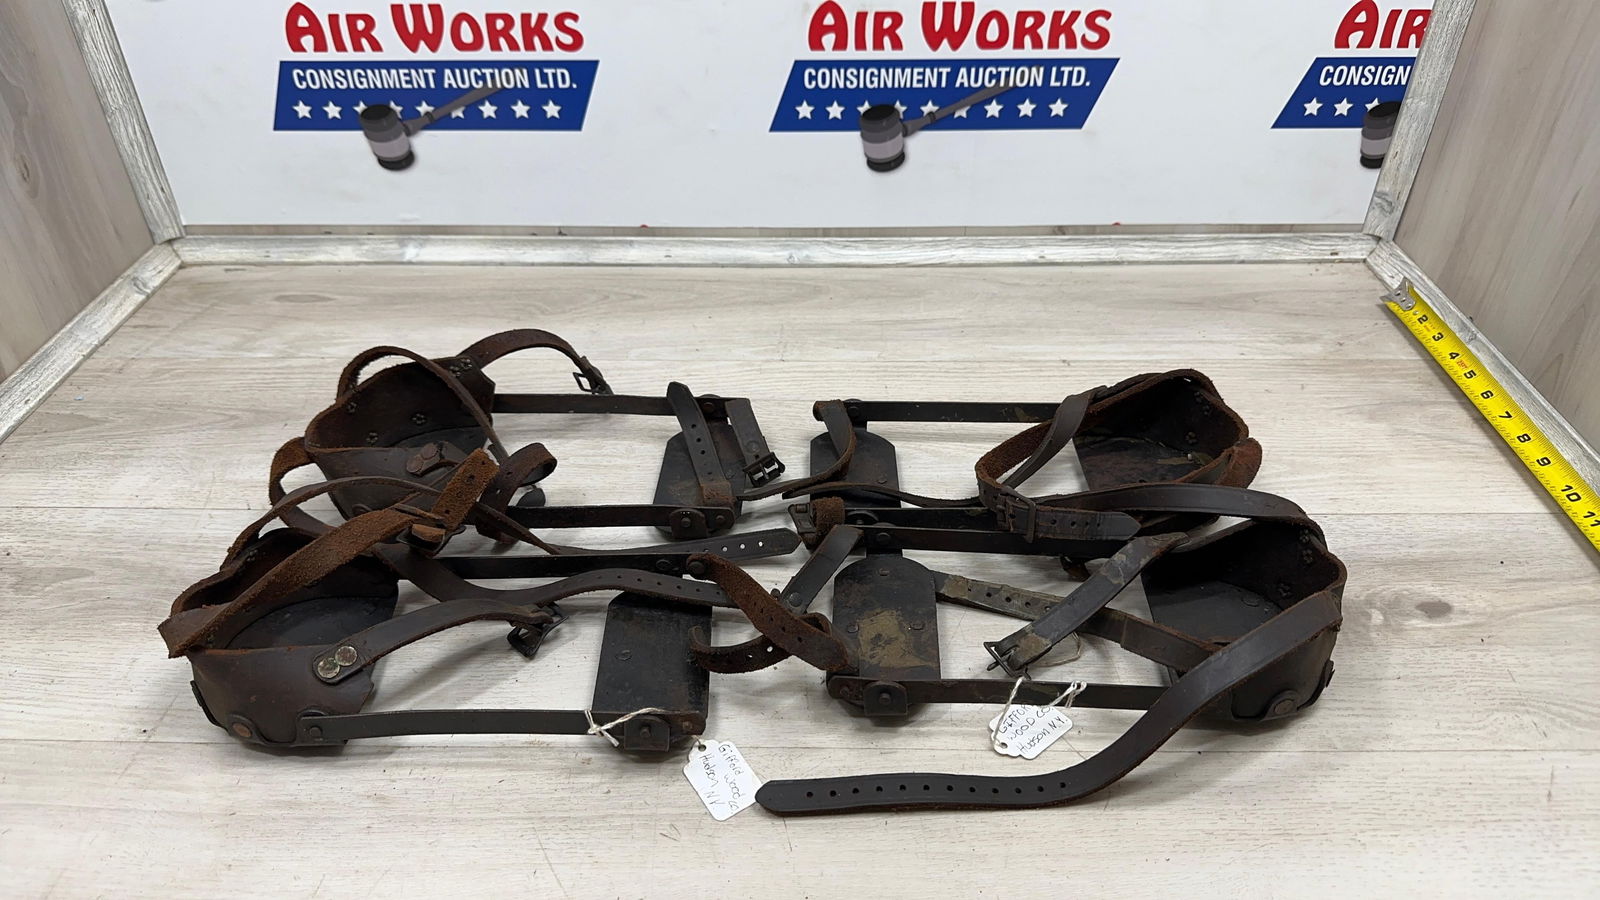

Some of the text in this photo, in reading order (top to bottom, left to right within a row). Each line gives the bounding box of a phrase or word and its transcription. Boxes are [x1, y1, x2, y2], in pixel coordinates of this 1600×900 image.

[285, 1, 584, 53] AIR WORKS
[807, 0, 1112, 52] AIR WORKS
[1334, 0, 1432, 49] AIR
[291, 67, 578, 91] CONSIGNMENT AUCTION LTD.
[803, 65, 1091, 90] CONSIGNMENT AUCTION LTD.
[1417, 314, 1429, 325] 2
[1432, 332, 1444, 342] 3
[1448, 351, 1460, 360] 4
[1464, 370, 1477, 380] 5
[1480, 390, 1494, 401] 6
[1498, 410, 1513, 421] 7
[1516, 433, 1532, 444] 8
[1536, 456, 1552, 467] 9
[1561, 484, 1582, 503] 10
[1583, 511, 1600, 528] 11
